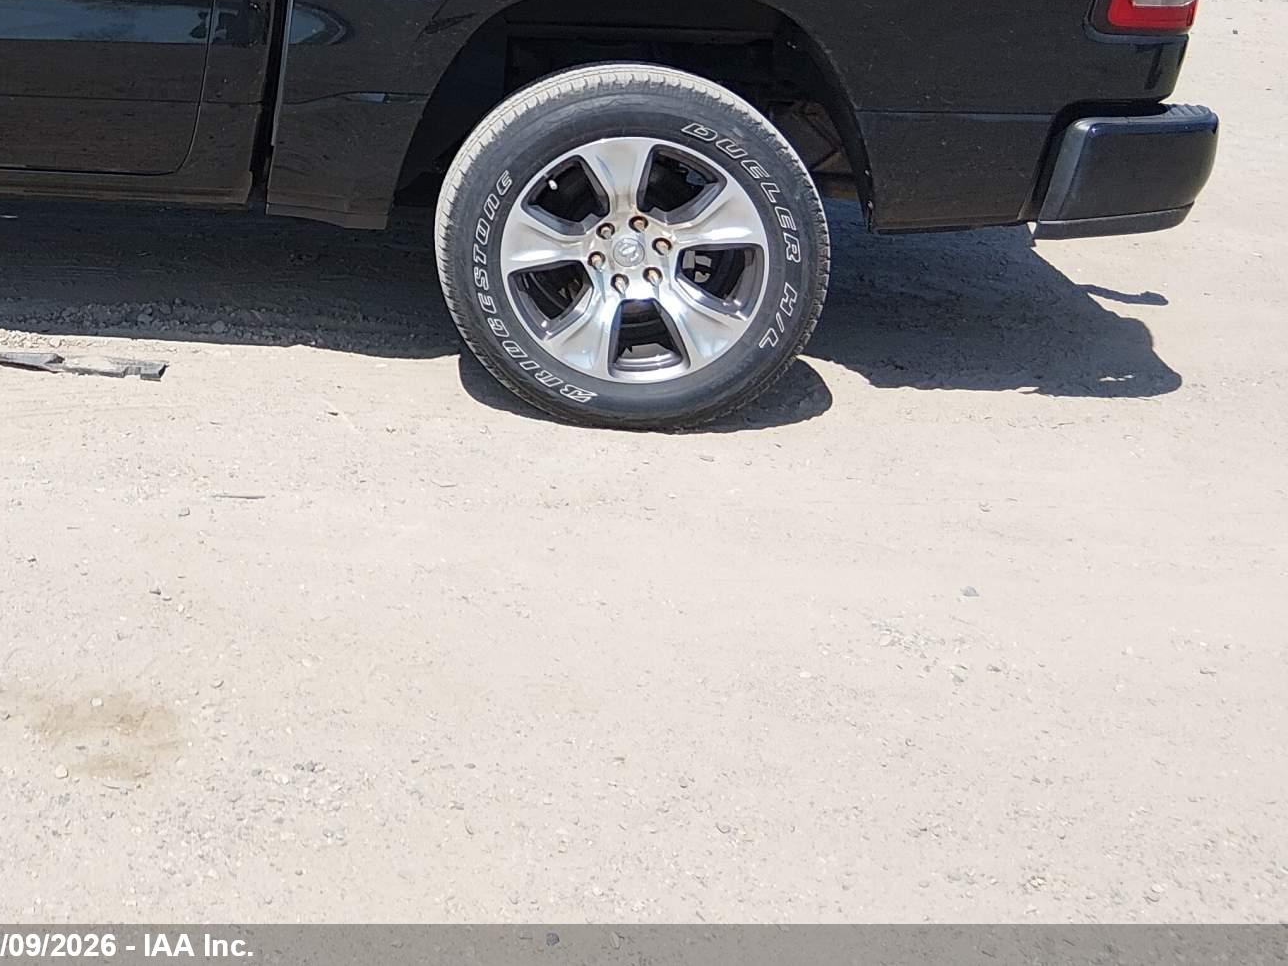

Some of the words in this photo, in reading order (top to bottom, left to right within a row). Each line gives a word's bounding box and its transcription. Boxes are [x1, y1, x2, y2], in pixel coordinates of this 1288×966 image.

[472, 169, 599, 404] BRIDGESTONE
[680, 121, 802, 264] DUELER
[758, 281, 799, 349] H/L
